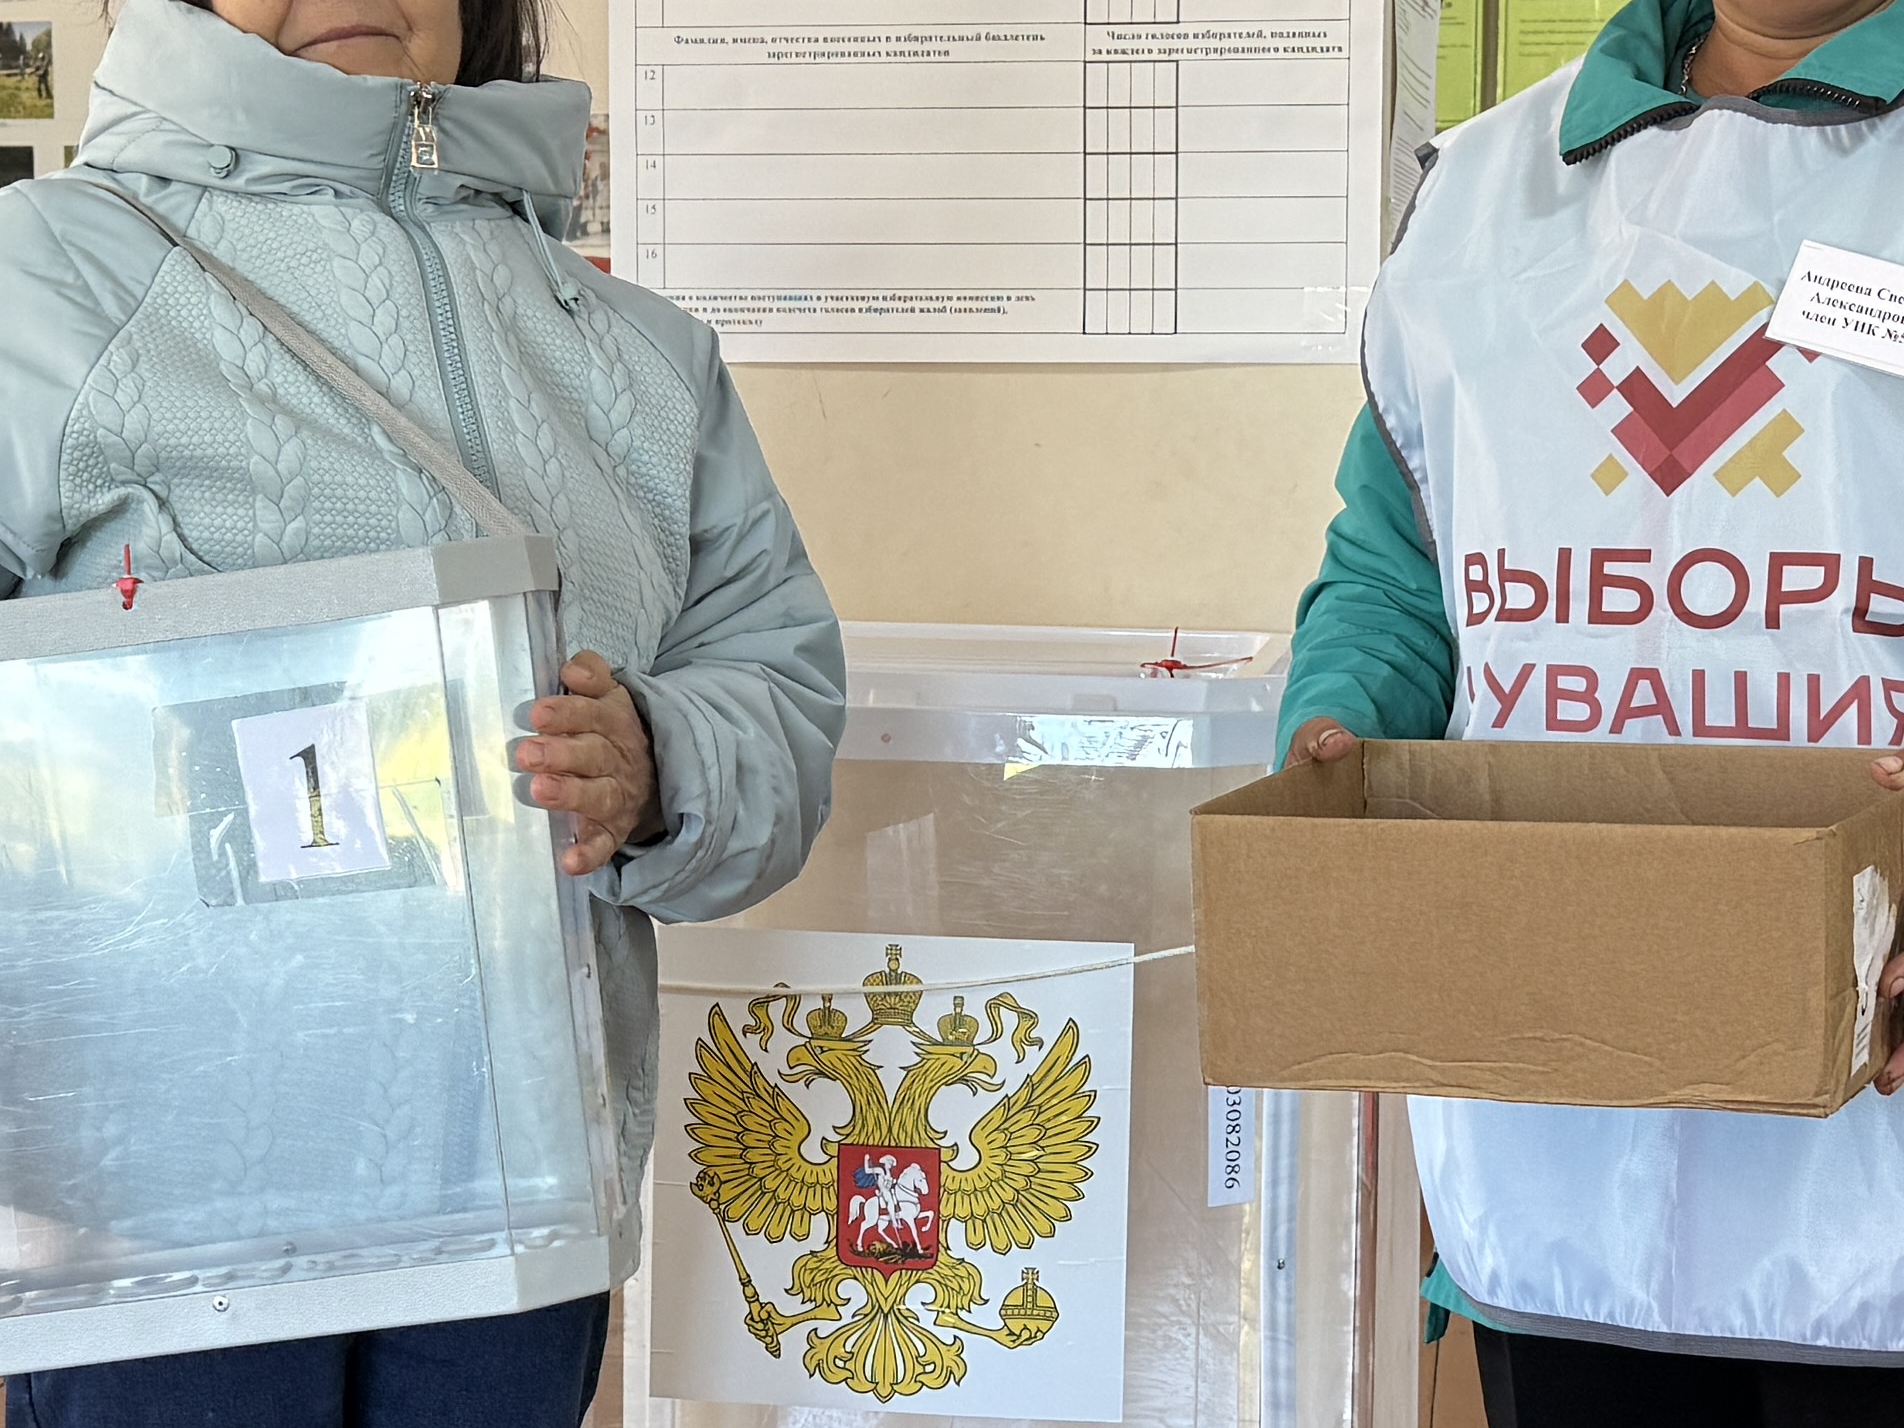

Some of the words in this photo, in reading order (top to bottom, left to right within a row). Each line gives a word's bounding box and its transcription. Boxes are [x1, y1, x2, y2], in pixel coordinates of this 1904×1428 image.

[644, 69, 656, 82] 12
[644, 113, 656, 127] 13
[645, 158, 657, 171] 14
[645, 203, 657, 216] 15
[645, 247, 658, 260] 16
[1800, 270, 1873, 297] Андреева
[1802, 309, 1837, 327] член
[1841, 316, 1880, 337] УИК
[289, 743, 340, 849] 1
